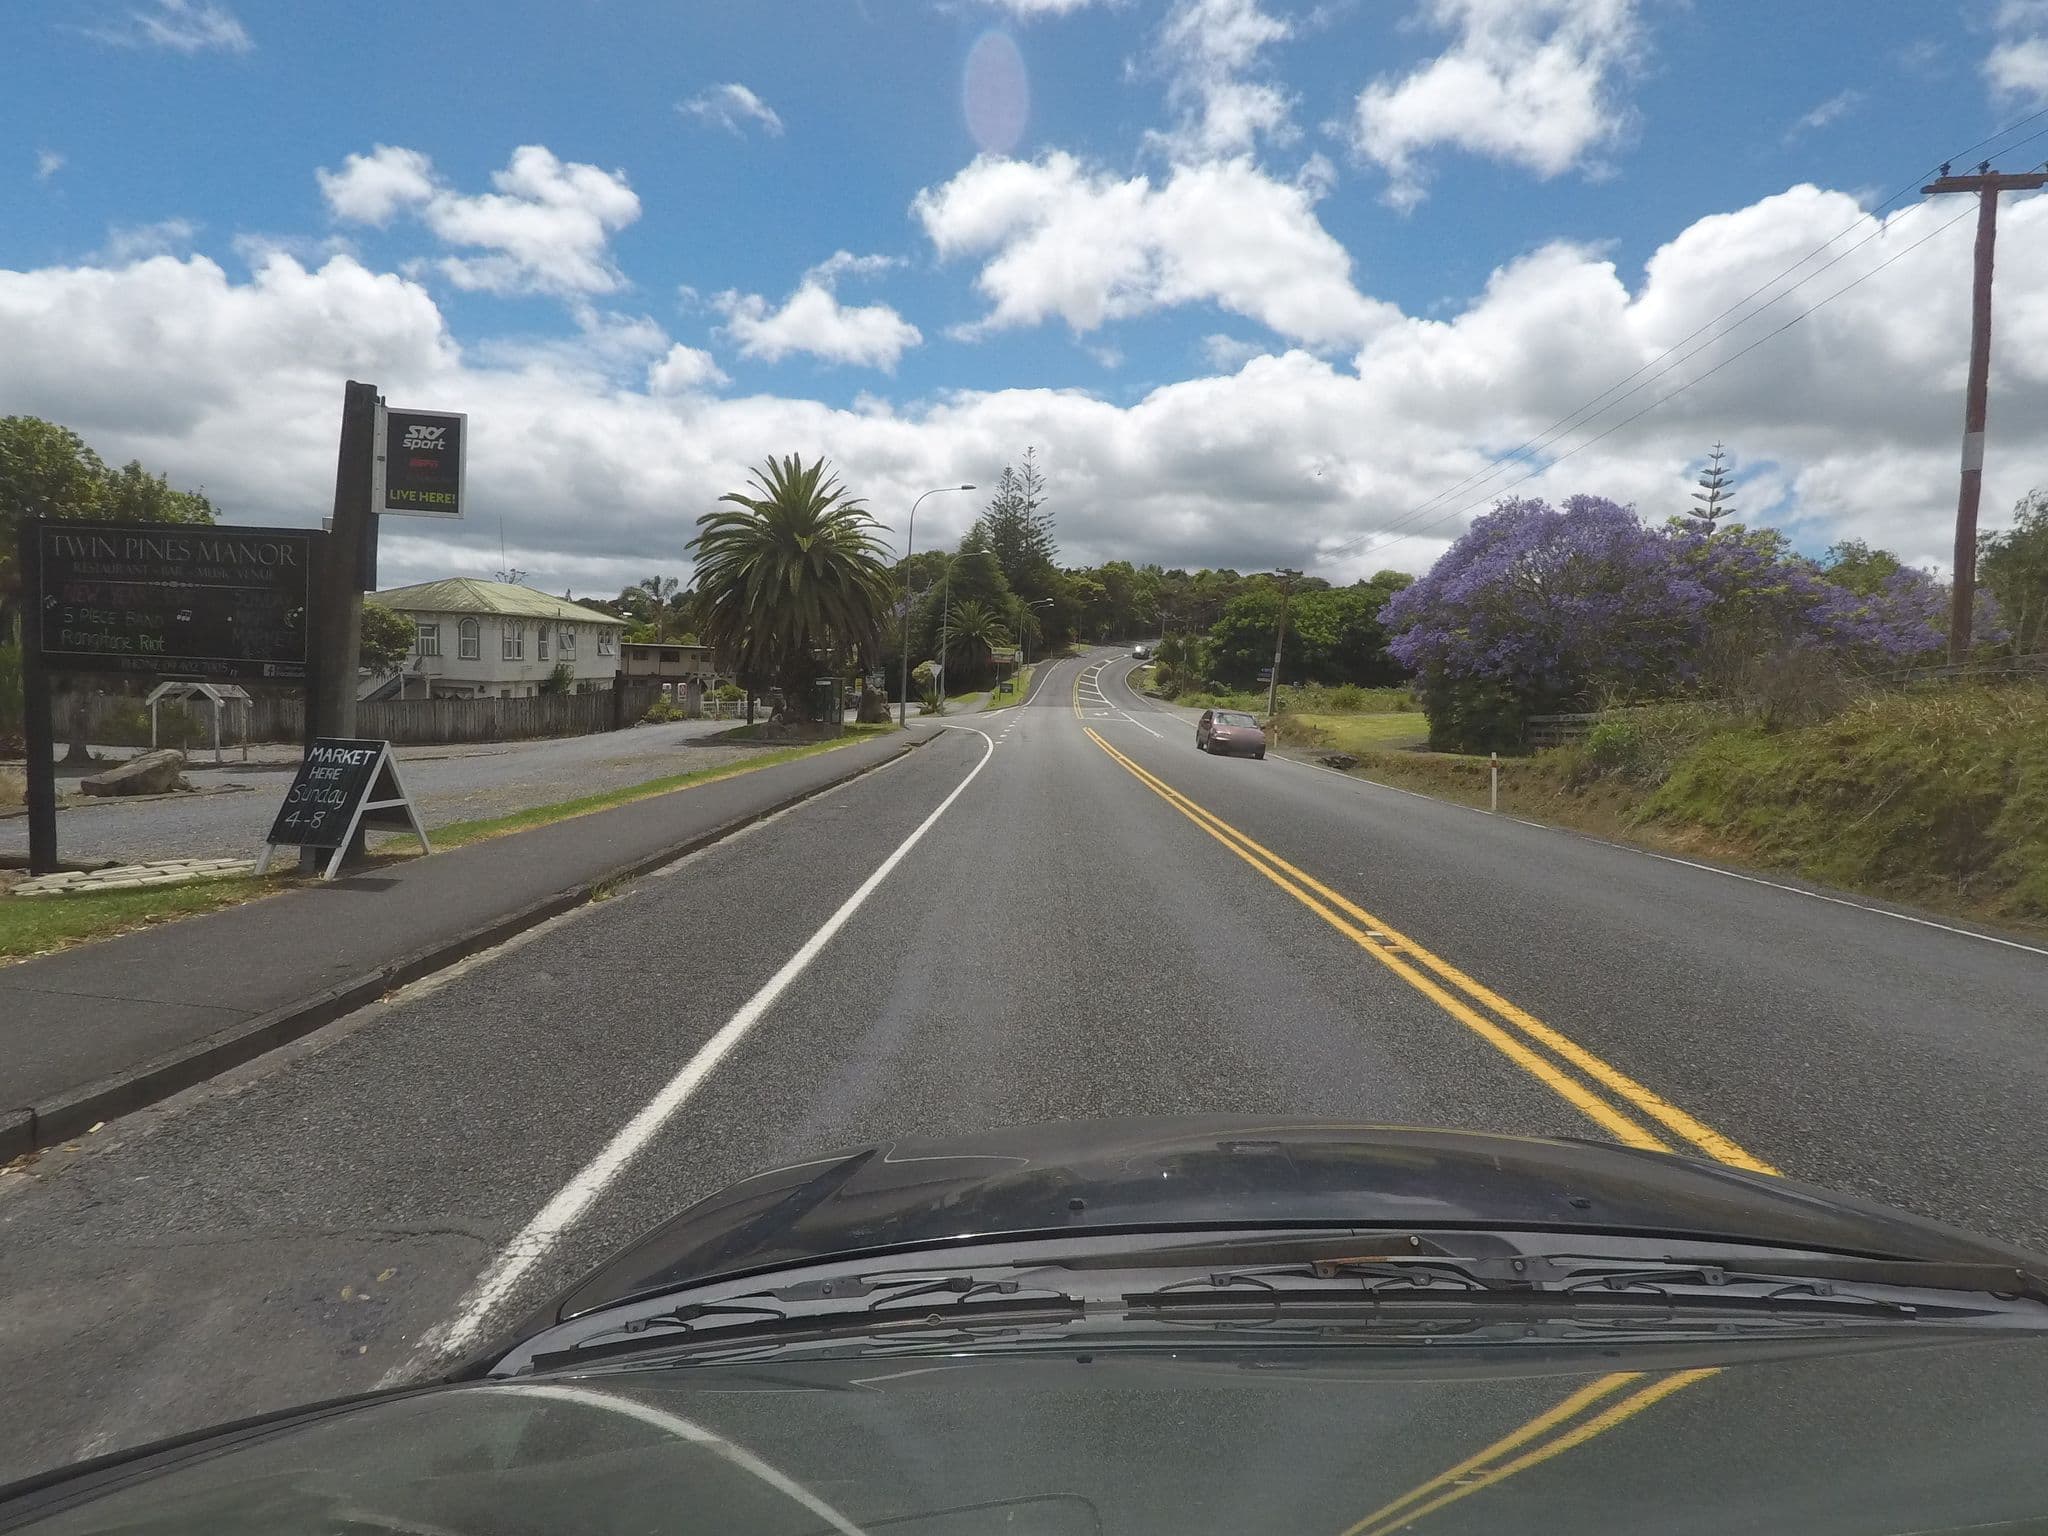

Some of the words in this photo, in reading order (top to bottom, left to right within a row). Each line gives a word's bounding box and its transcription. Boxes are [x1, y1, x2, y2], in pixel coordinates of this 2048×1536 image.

[405, 425, 447, 440] SKY
[402, 438, 446, 450] sport
[390, 489, 417, 501] LIVE
[419, 491, 455, 504] HERE!
[55, 535, 116, 558] TWIN
[126, 537, 191, 561] PINES
[198, 541, 297, 567] MANOR
[79, 607, 121, 625] PIECE
[307, 747, 377, 766] MARKET
[308, 766, 343, 780] HERE
[288, 783, 348, 810] Sunday
[285, 810, 327, 829] 4-8
